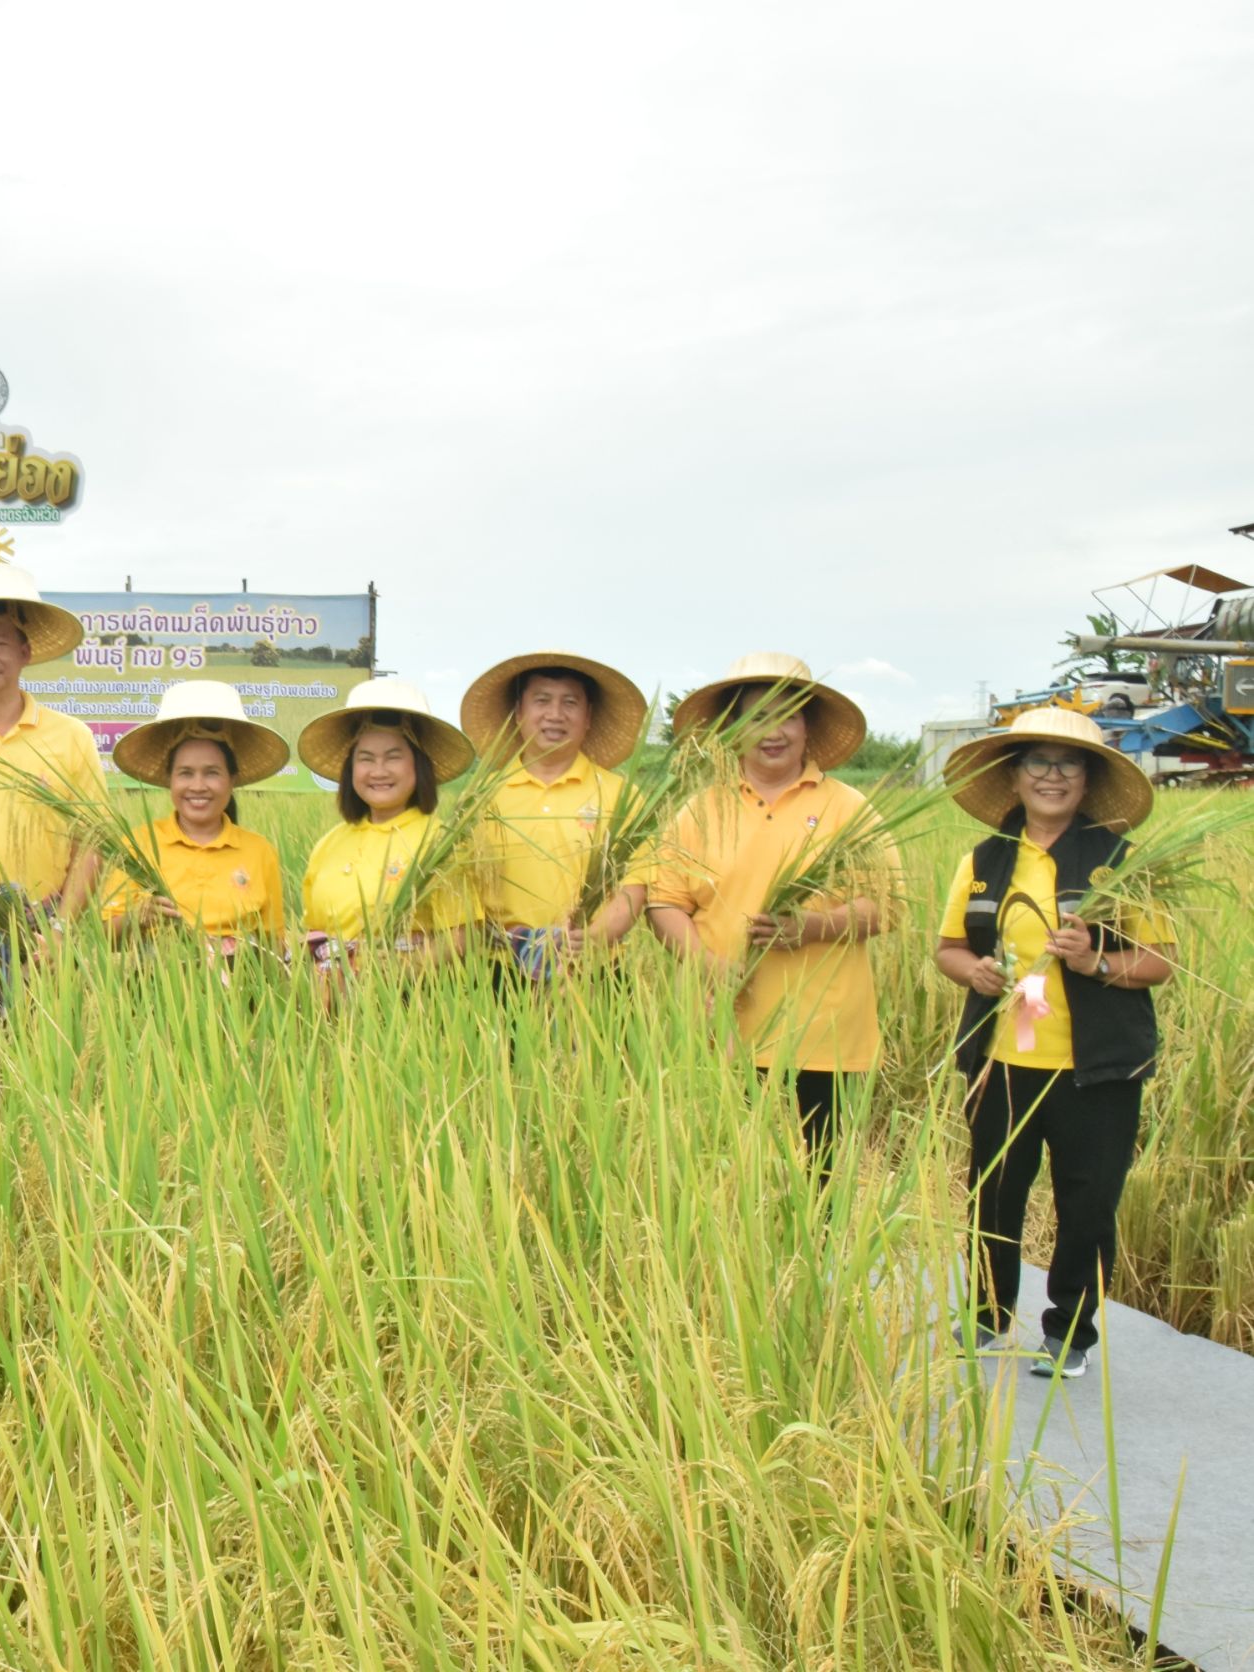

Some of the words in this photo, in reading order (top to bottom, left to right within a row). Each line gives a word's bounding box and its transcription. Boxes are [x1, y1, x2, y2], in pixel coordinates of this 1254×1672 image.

[75, 639, 125, 673] พันธุ์
[133, 648, 163, 667] กข
[173, 648, 203, 668] 95
